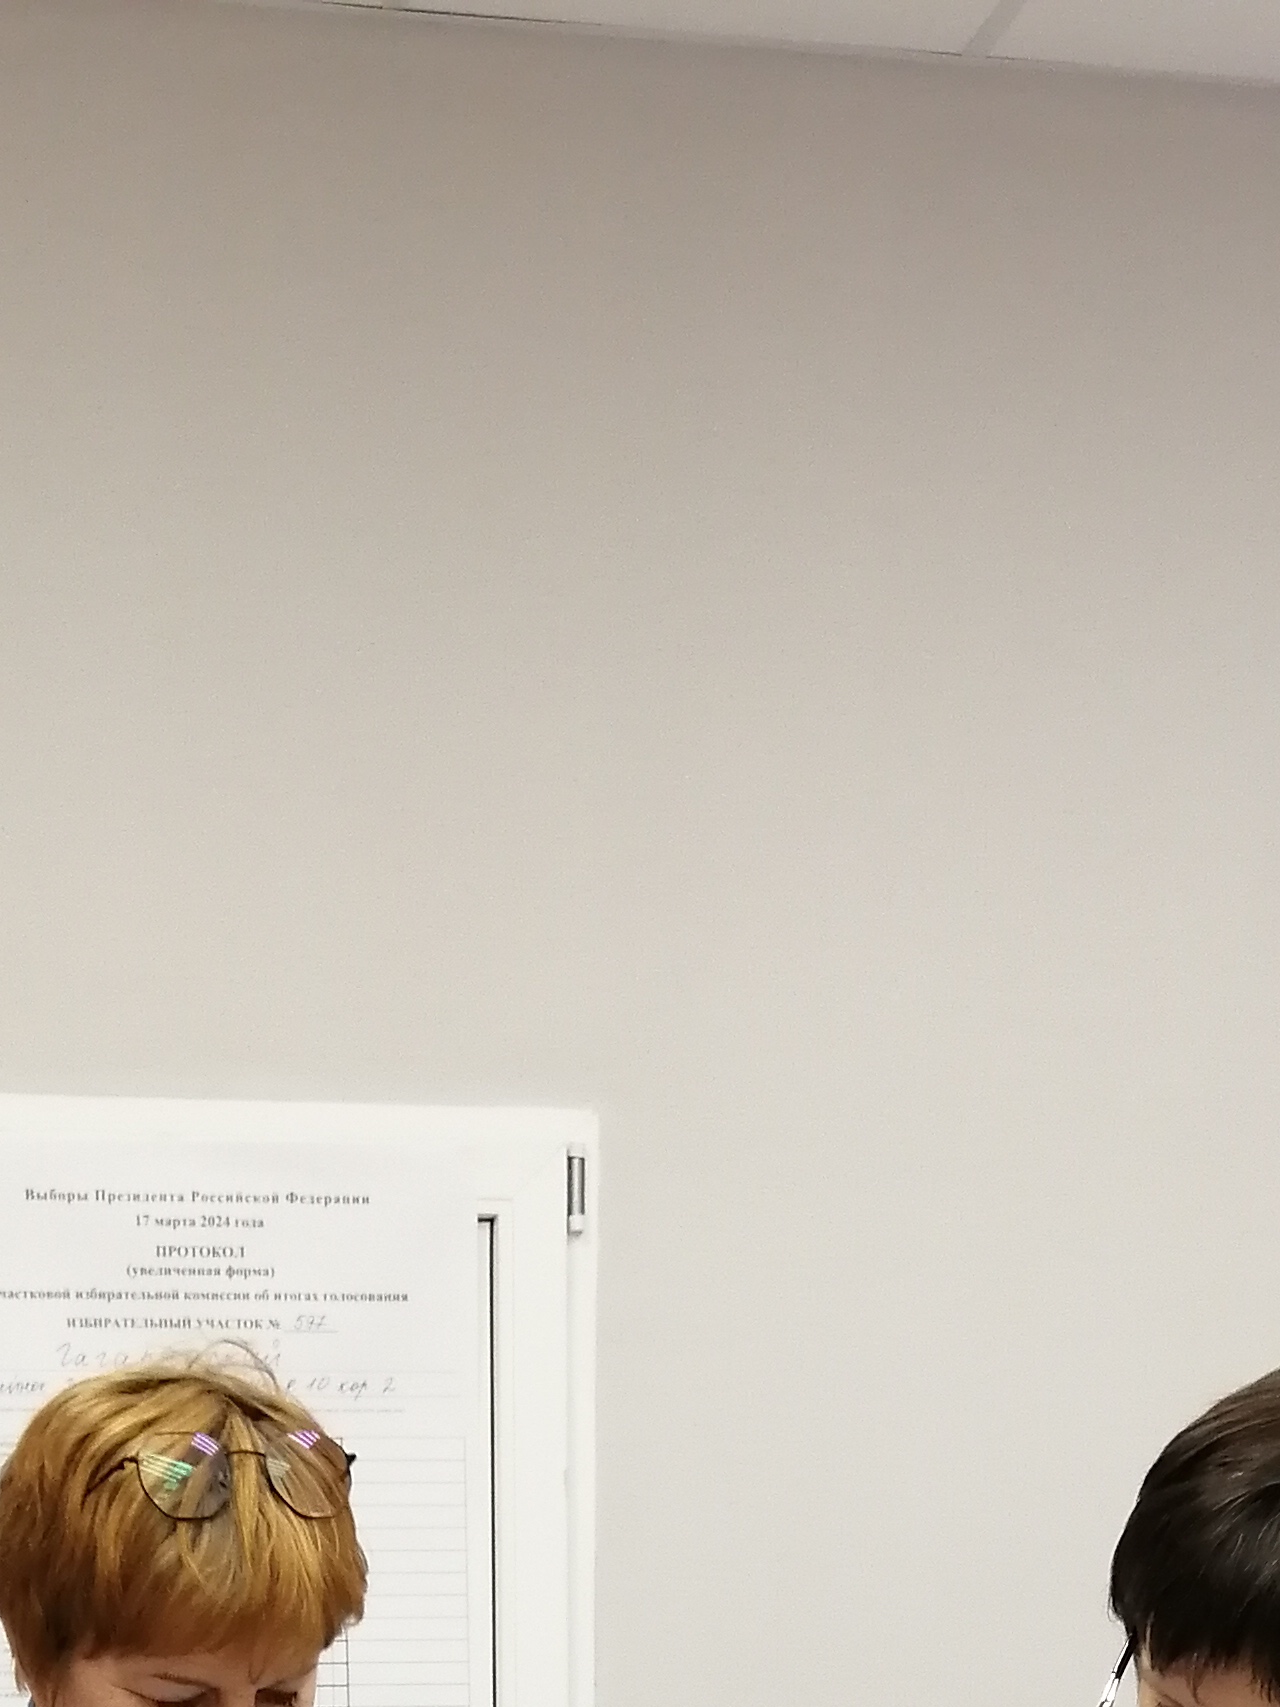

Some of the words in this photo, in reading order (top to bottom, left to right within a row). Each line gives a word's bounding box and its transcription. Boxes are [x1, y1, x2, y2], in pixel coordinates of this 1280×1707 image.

[25, 1189, 89, 1205] Выборы
[96, 1190, 185, 1206] Президента
[191, 1191, 279, 1205] Российской
[286, 1193, 371, 1207] Федерации
[135, 1215, 150, 1227] 17
[155, 1218, 196, 1230] марта
[200, 1215, 230, 1228] 2024
[234, 1218, 264, 1229] года
[156, 1245, 246, 1258] ПРОТОКОЛ
[126, 1265, 221, 1278] (увеличенная
[225, 1266, 276, 1278] форма)
[75, 1288, 179, 1302] избирательной
[184, 1291, 250, 1301] комиссии
[254, 1290, 270, 1301] об
[274, 1293, 319, 1303] итогах
[323, 1293, 409, 1303] голосования
[67, 1315, 192, 1329] ИЗБИРАТЕЛЬНЫЙ
[195, 1318, 263, 1330] УЧАСТОК
[294, 1315, 330, 1331] 597
